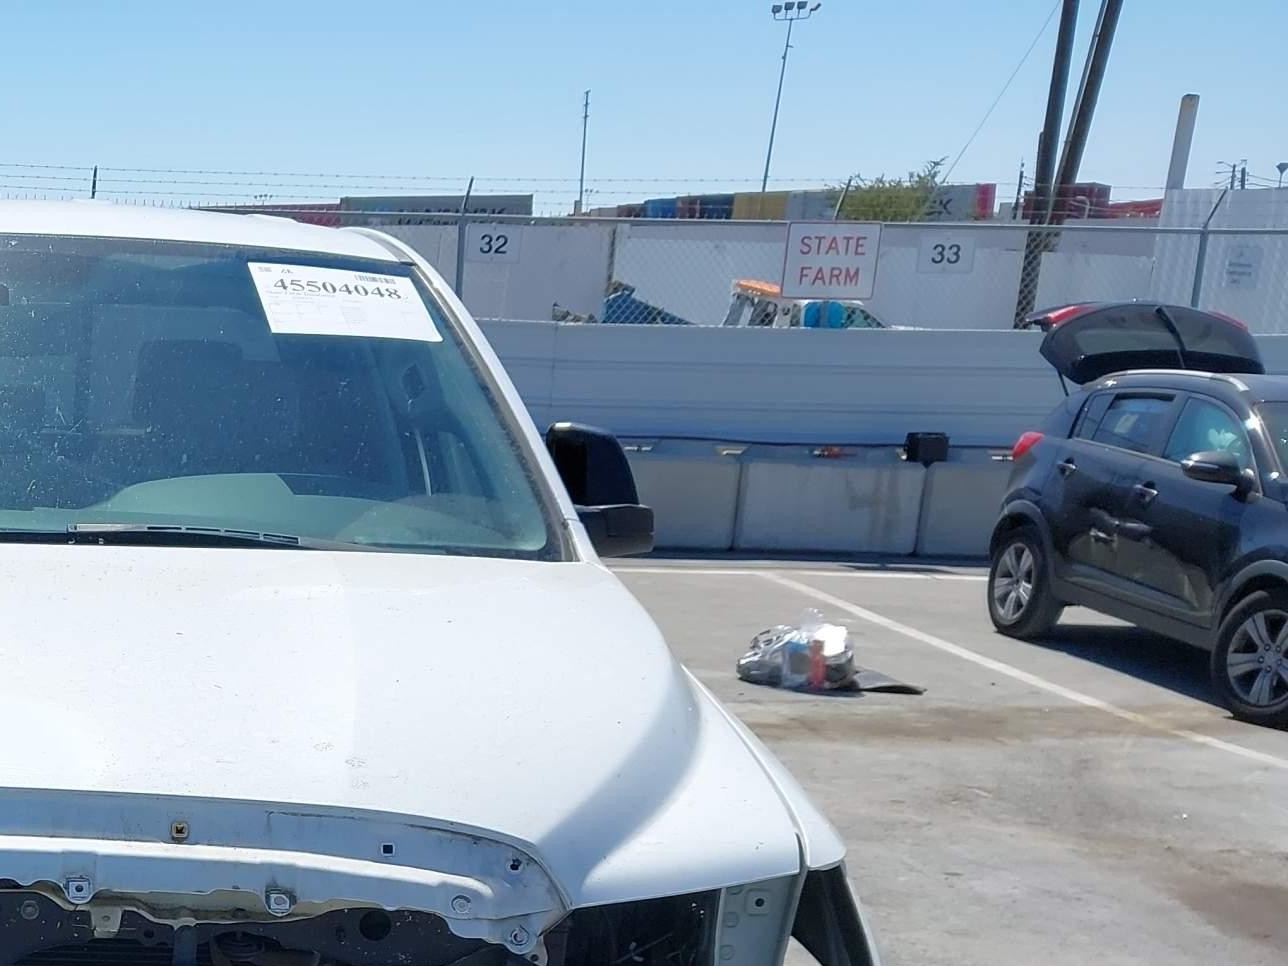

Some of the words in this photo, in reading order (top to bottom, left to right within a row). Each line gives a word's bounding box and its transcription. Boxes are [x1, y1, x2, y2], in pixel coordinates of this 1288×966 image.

[479, 233, 509, 254] 32
[799, 235, 868, 256] STATE
[931, 243, 961, 265] 33
[799, 266, 861, 287] FARM
[273, 277, 402, 301] 45504048
